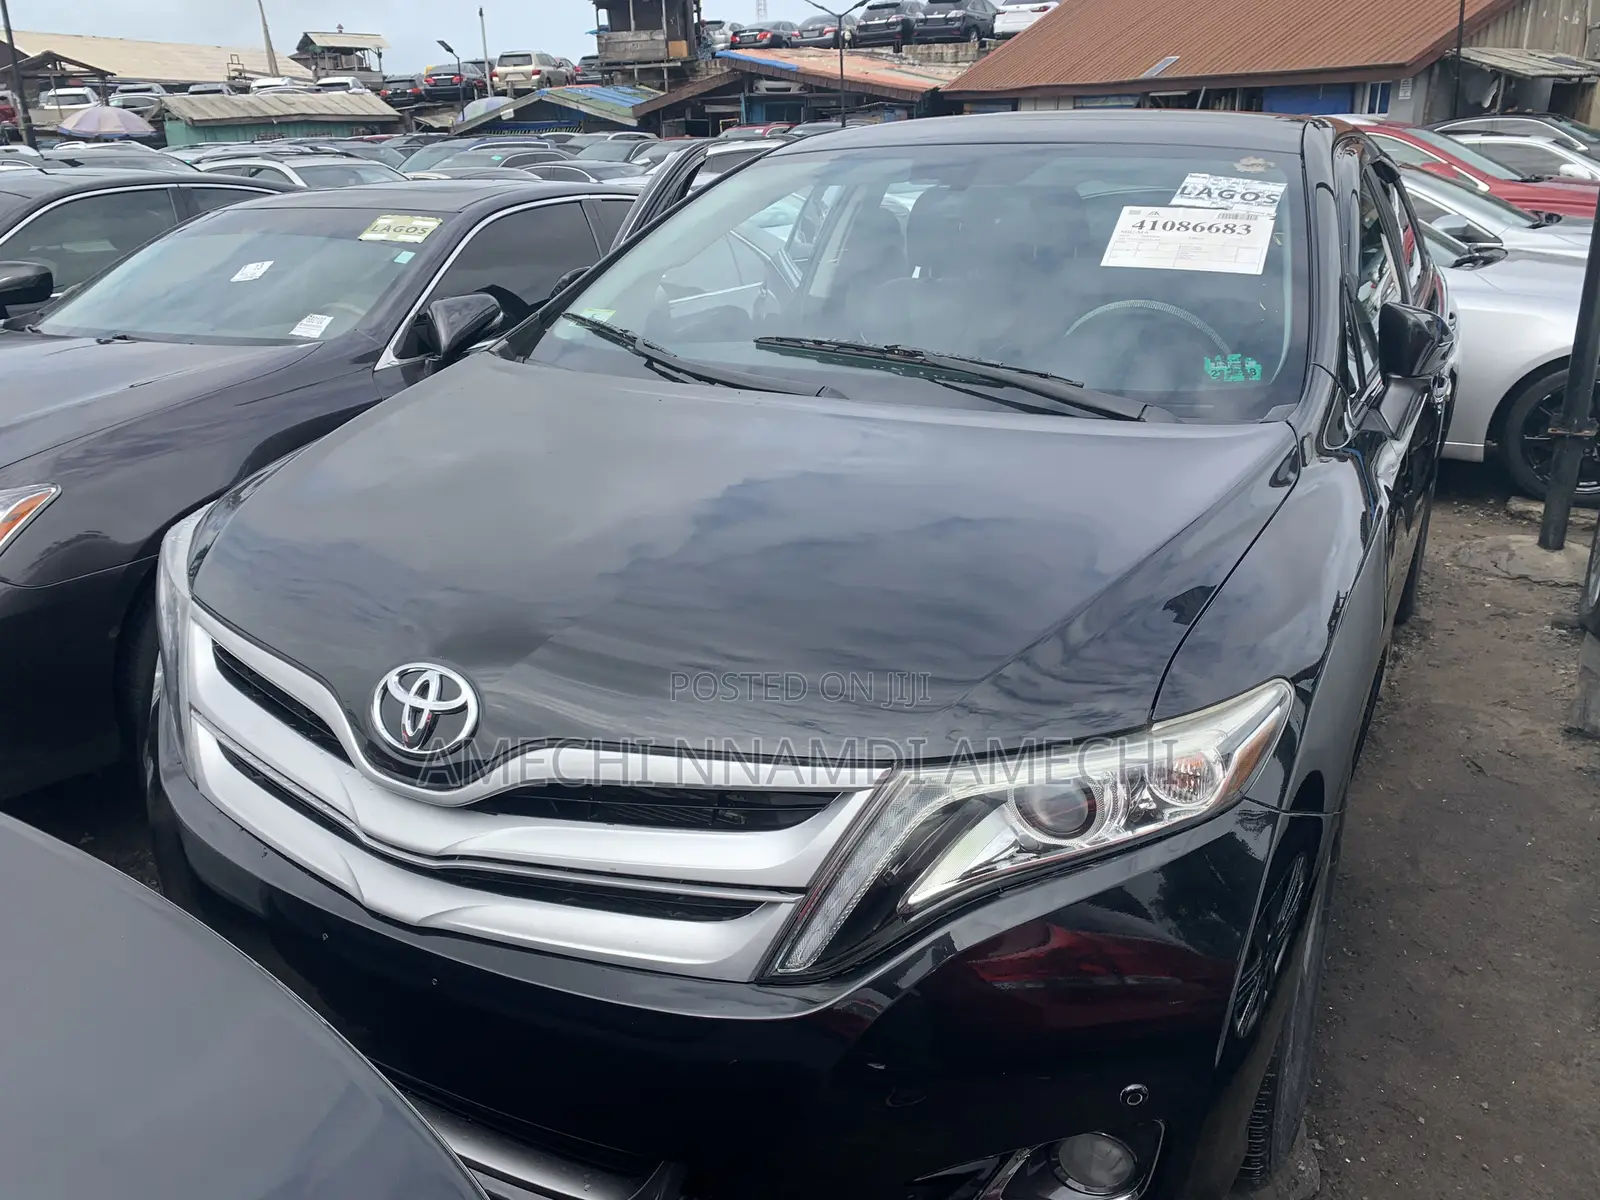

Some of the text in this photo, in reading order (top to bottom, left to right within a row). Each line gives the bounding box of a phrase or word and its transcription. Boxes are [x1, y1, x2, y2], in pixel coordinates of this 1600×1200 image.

[1179, 184, 1281, 204] LAGOS
[370, 224, 431, 235] LAGOS
[1132, 219, 1252, 236] 41086683
